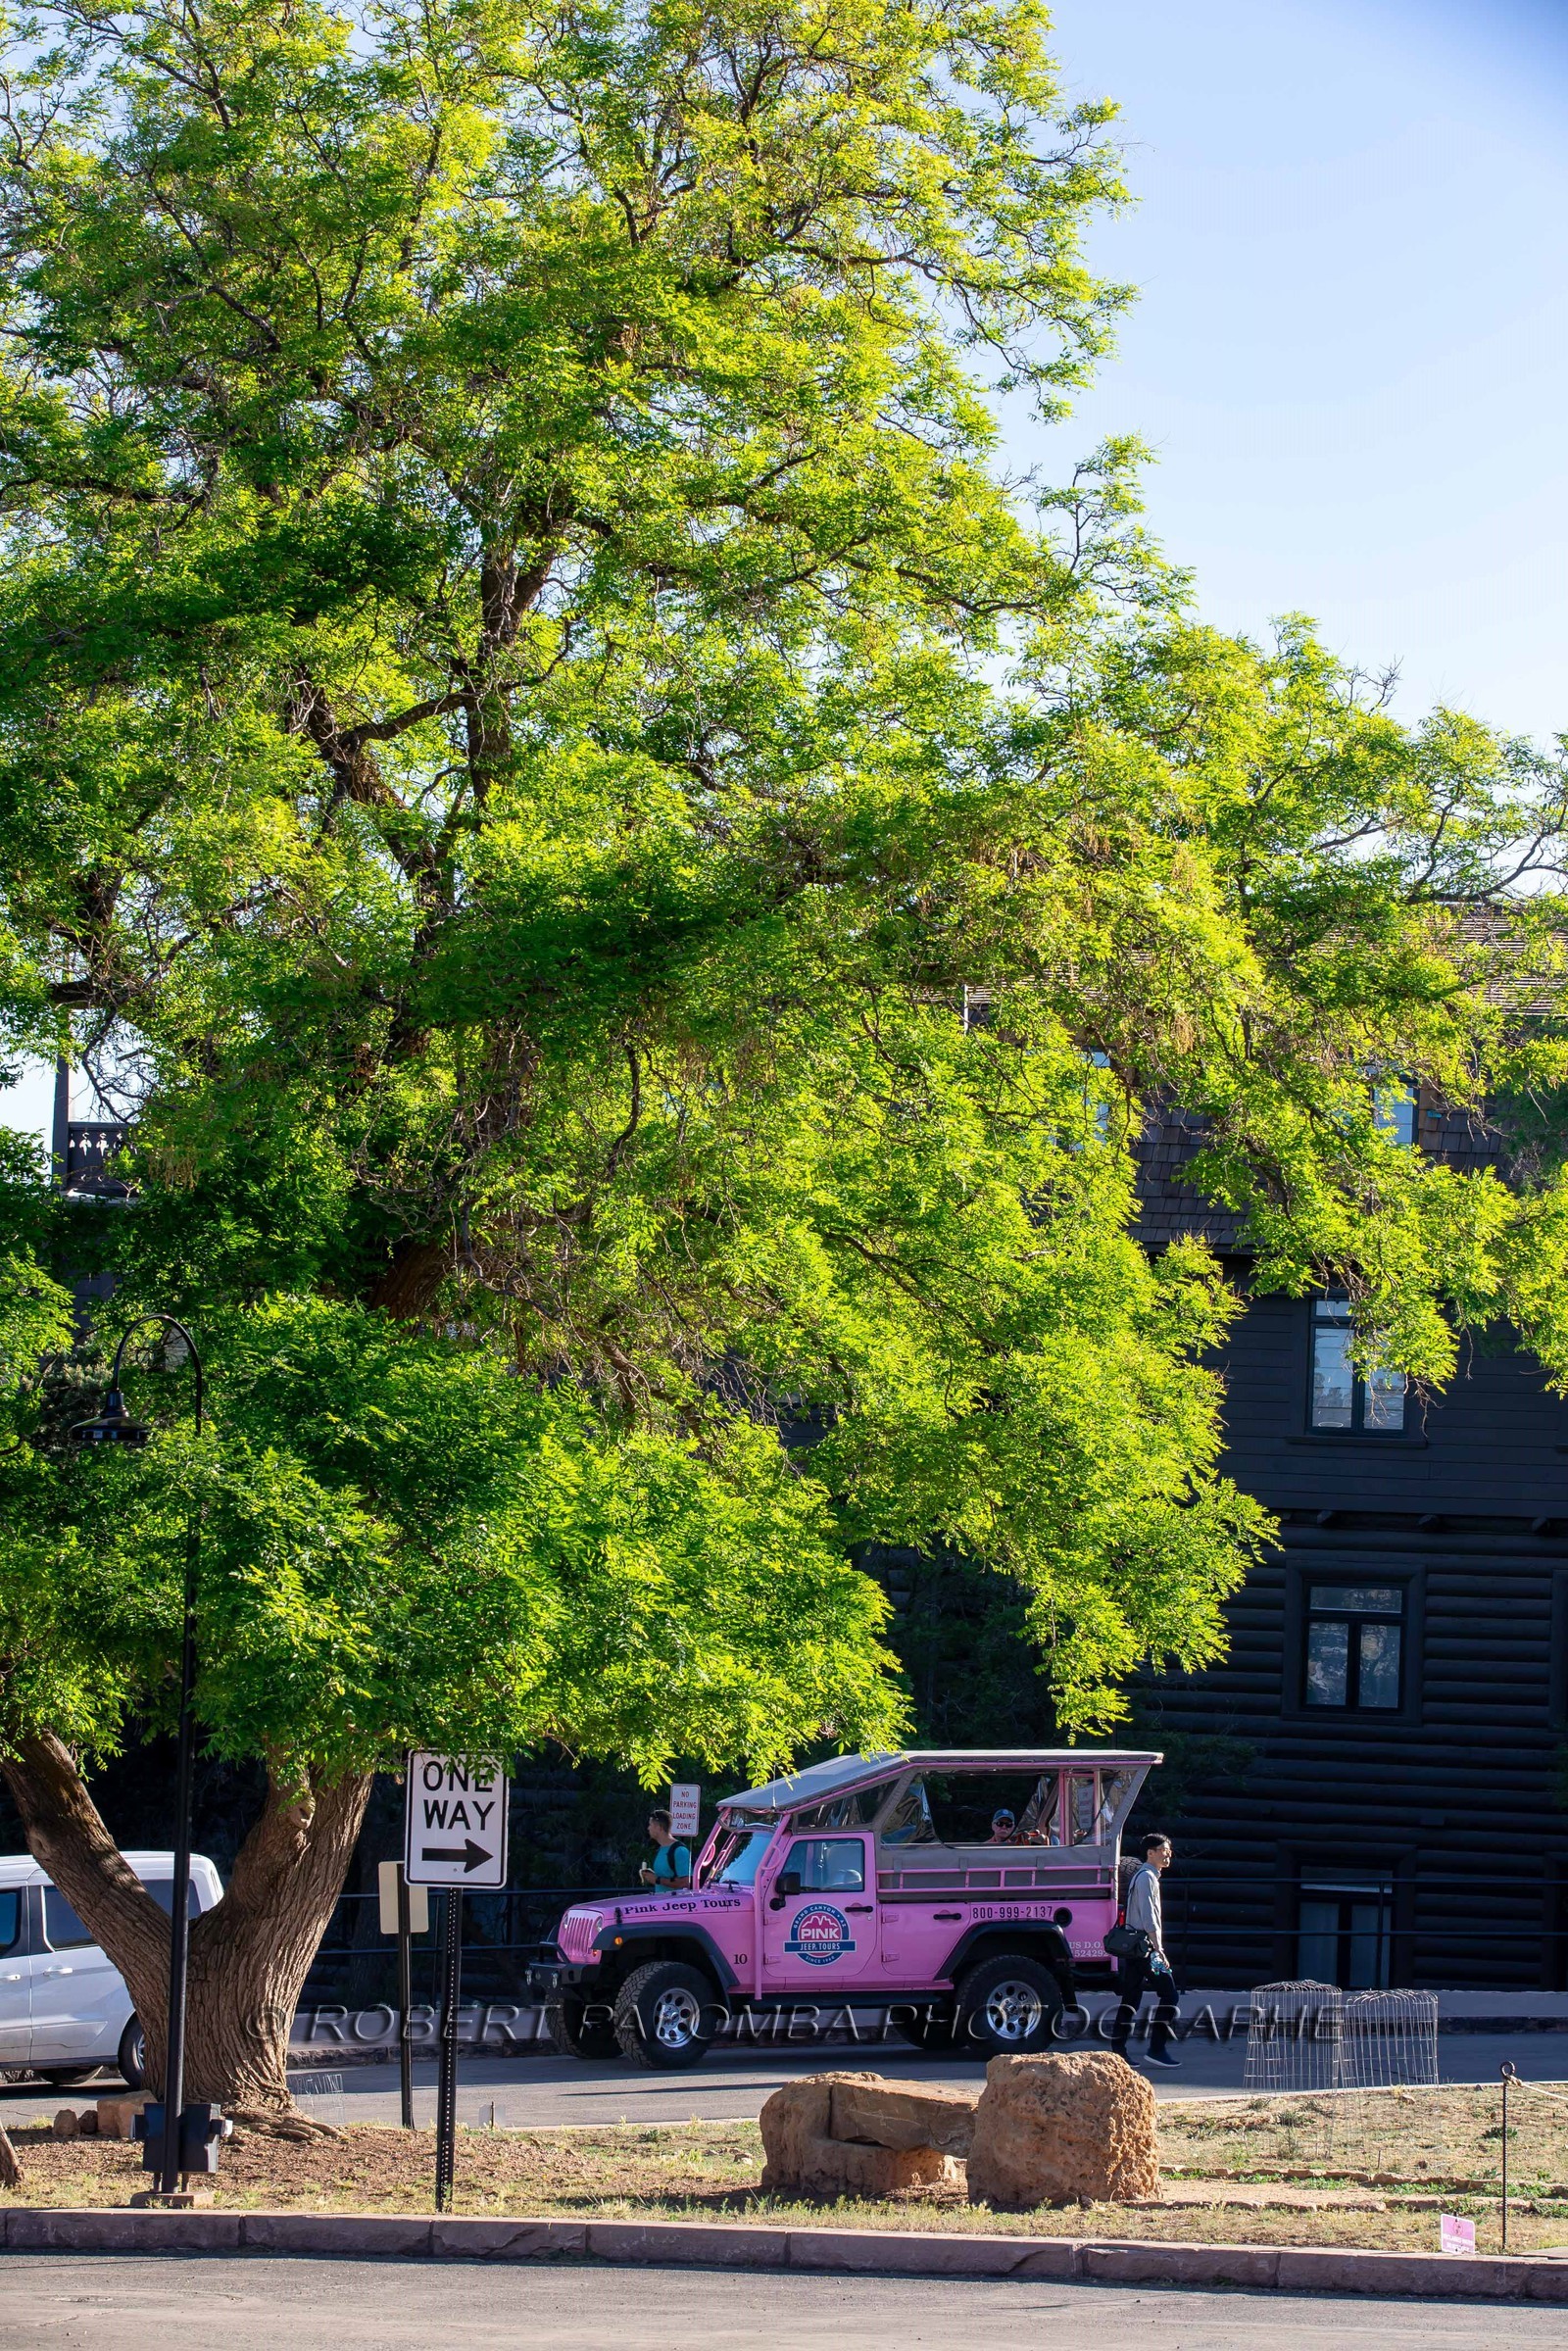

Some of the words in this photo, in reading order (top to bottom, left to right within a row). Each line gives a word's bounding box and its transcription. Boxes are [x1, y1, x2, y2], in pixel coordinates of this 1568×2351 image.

[422, 1760, 493, 1792] ONE
[423, 1799, 496, 1831] WAY
[624, 1904, 658, 1915] Pink
[662, 1901, 697, 1912] Jeep
[700, 1898, 741, 1909] Tours
[972, 1905, 1054, 1919] 800-999-2137
[793, 1910, 808, 1929] GRAND
[809, 1905, 836, 1914] CANYON
[801, 1928, 839, 1939] PINK
[733, 1953, 748, 1965] 10
